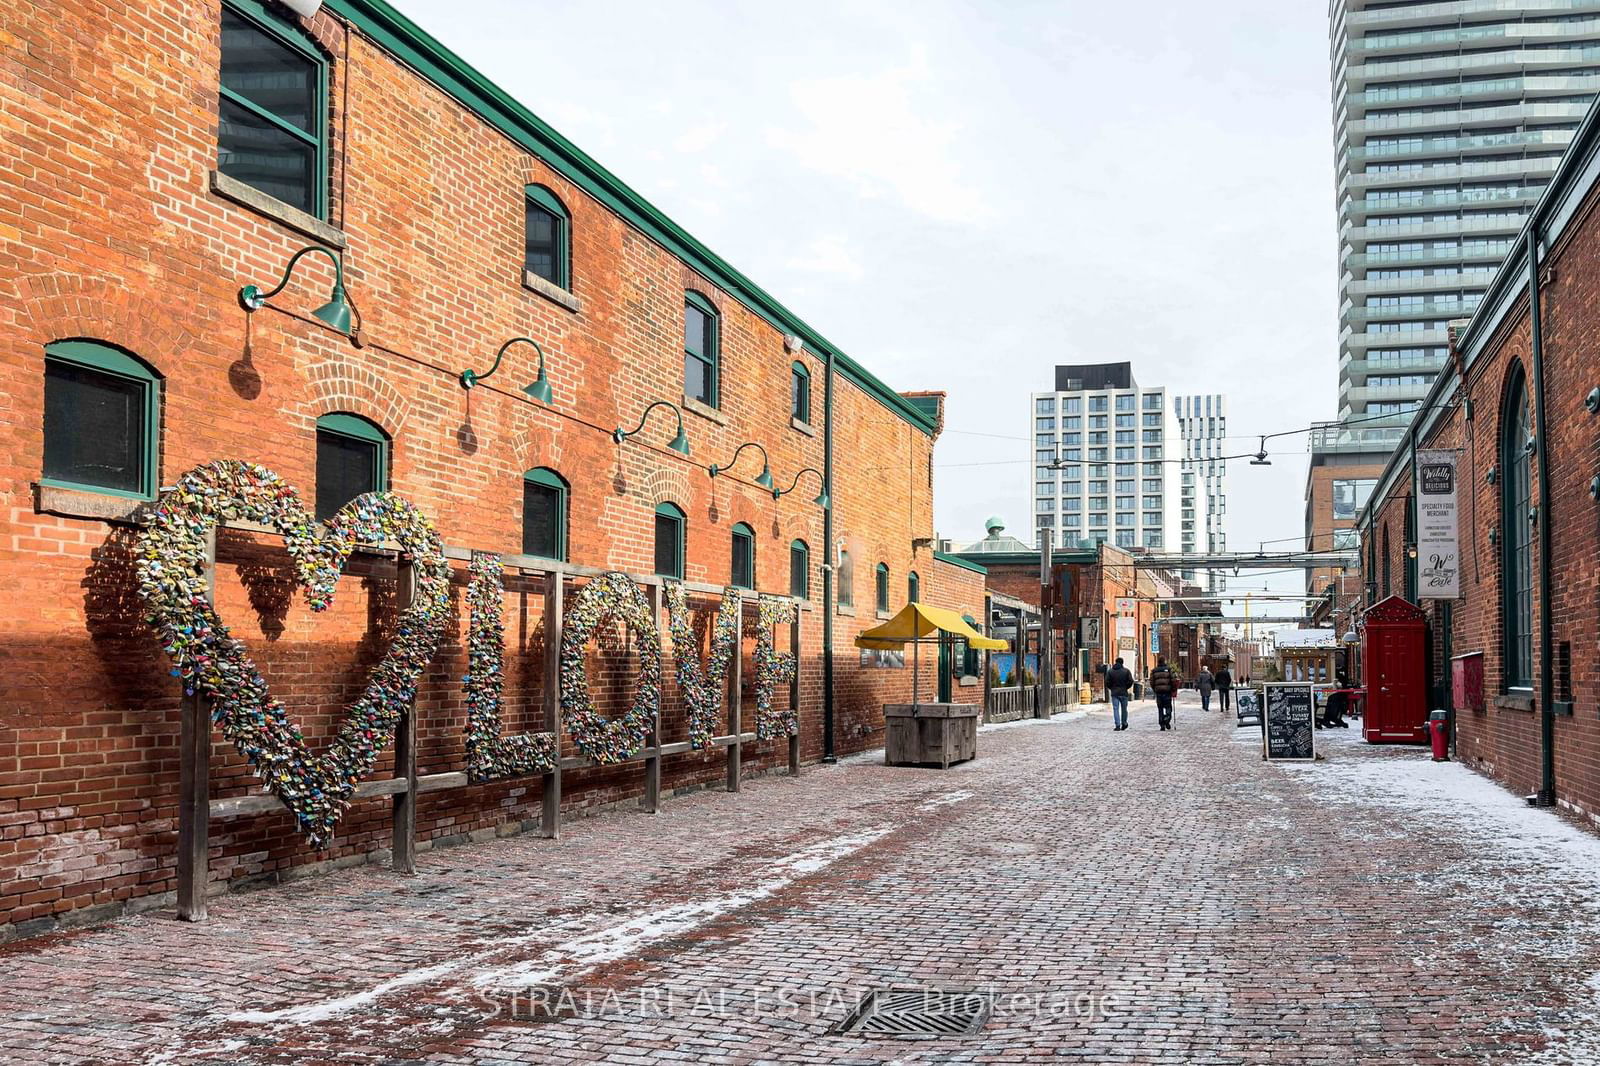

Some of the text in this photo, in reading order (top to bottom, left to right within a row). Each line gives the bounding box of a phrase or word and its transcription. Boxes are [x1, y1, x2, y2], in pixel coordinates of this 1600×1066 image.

[1423, 467, 1450, 480] Wildly
[1443, 502, 1454, 510] FOOD
[464, 549, 797, 784] LOVE
